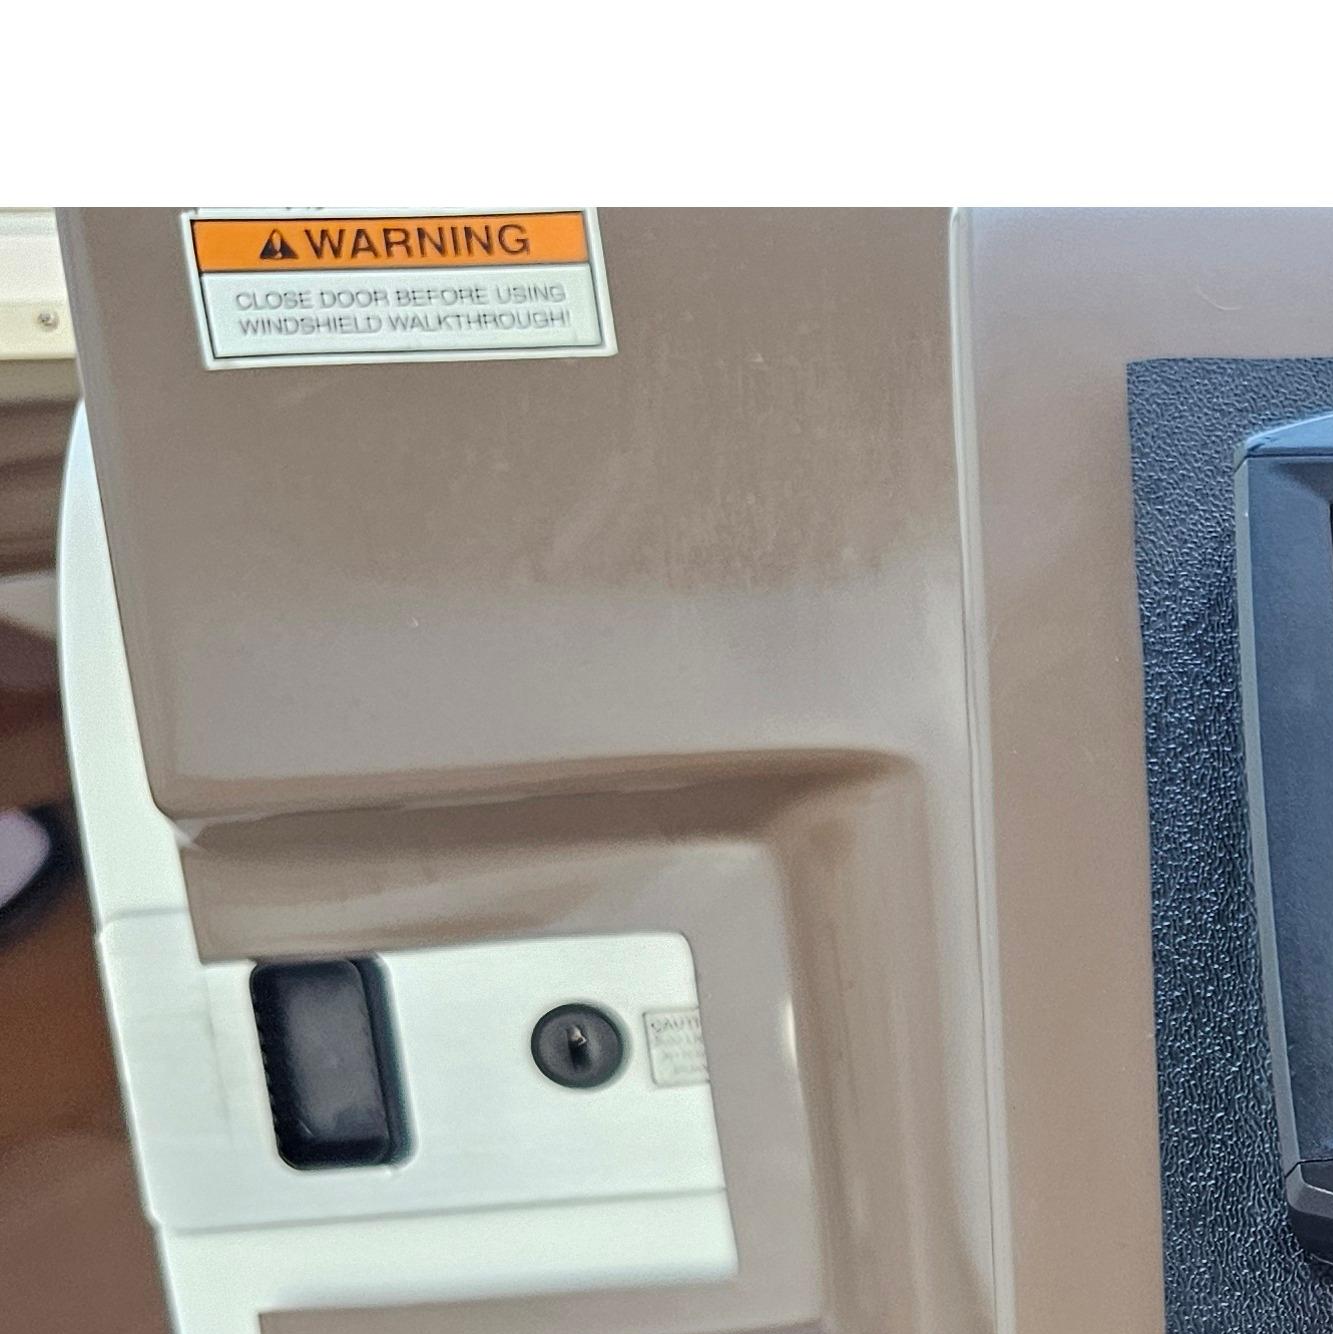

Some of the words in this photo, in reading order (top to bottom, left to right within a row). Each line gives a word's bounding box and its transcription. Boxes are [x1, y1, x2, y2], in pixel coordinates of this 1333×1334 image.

[304, 223, 531, 260] WARNING
[235, 289, 313, 311] CLOSE
[319, 288, 388, 310] DOOR
[397, 285, 488, 307] BEFORE
[496, 282, 566, 304] USING
[239, 313, 383, 337] WINDSHIELD
[388, 309, 571, 333] WALKTHROUGH!
